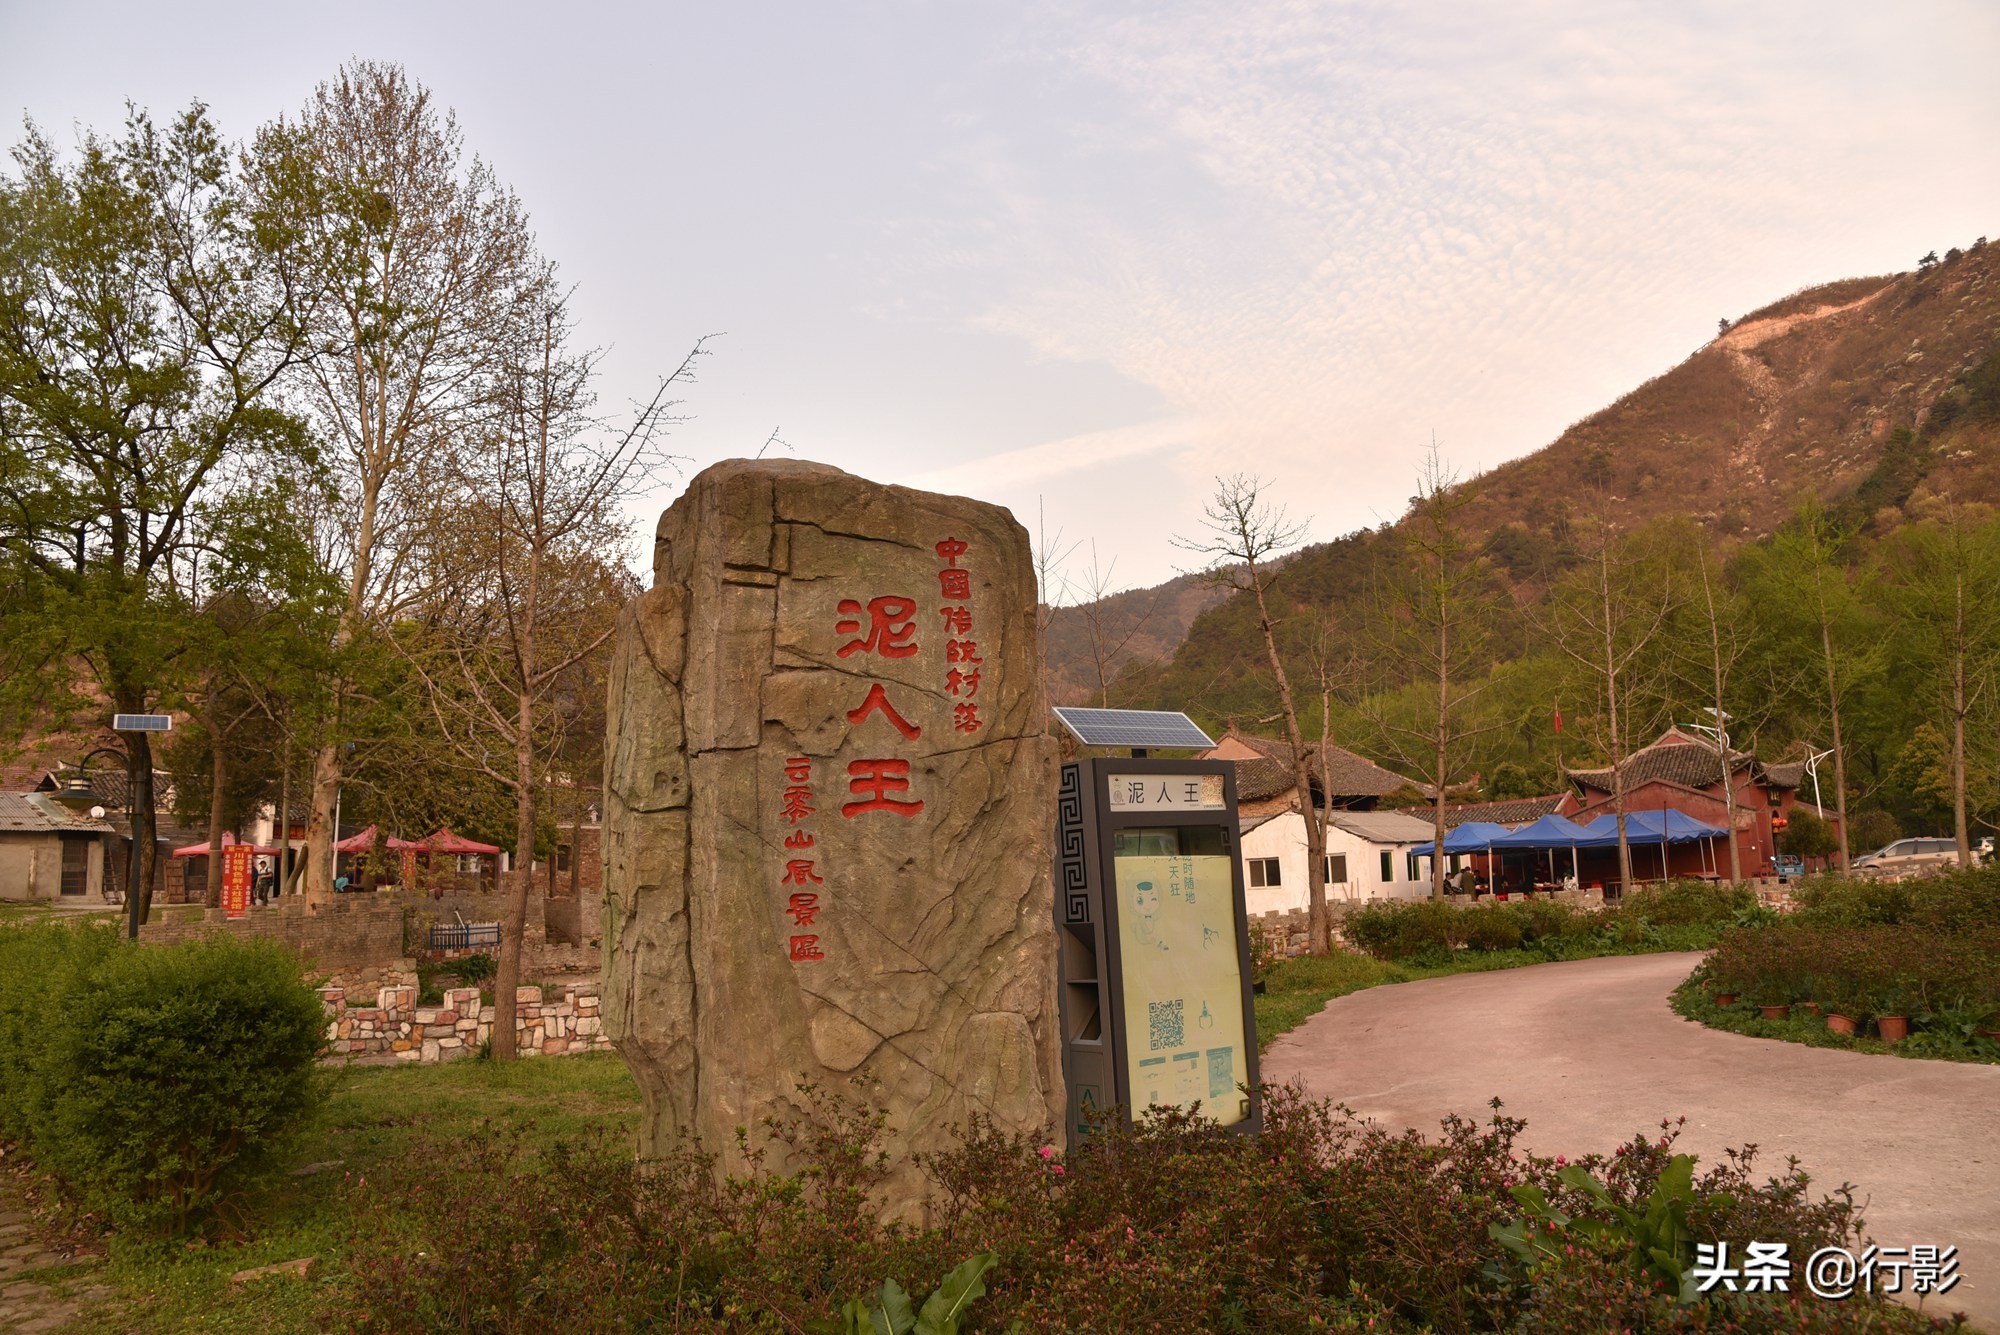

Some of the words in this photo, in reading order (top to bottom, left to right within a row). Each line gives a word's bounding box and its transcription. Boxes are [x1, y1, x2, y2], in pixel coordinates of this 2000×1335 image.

[835, 597, 924, 819] 泥人王
[1128, 782, 1199, 803] 泥人王
